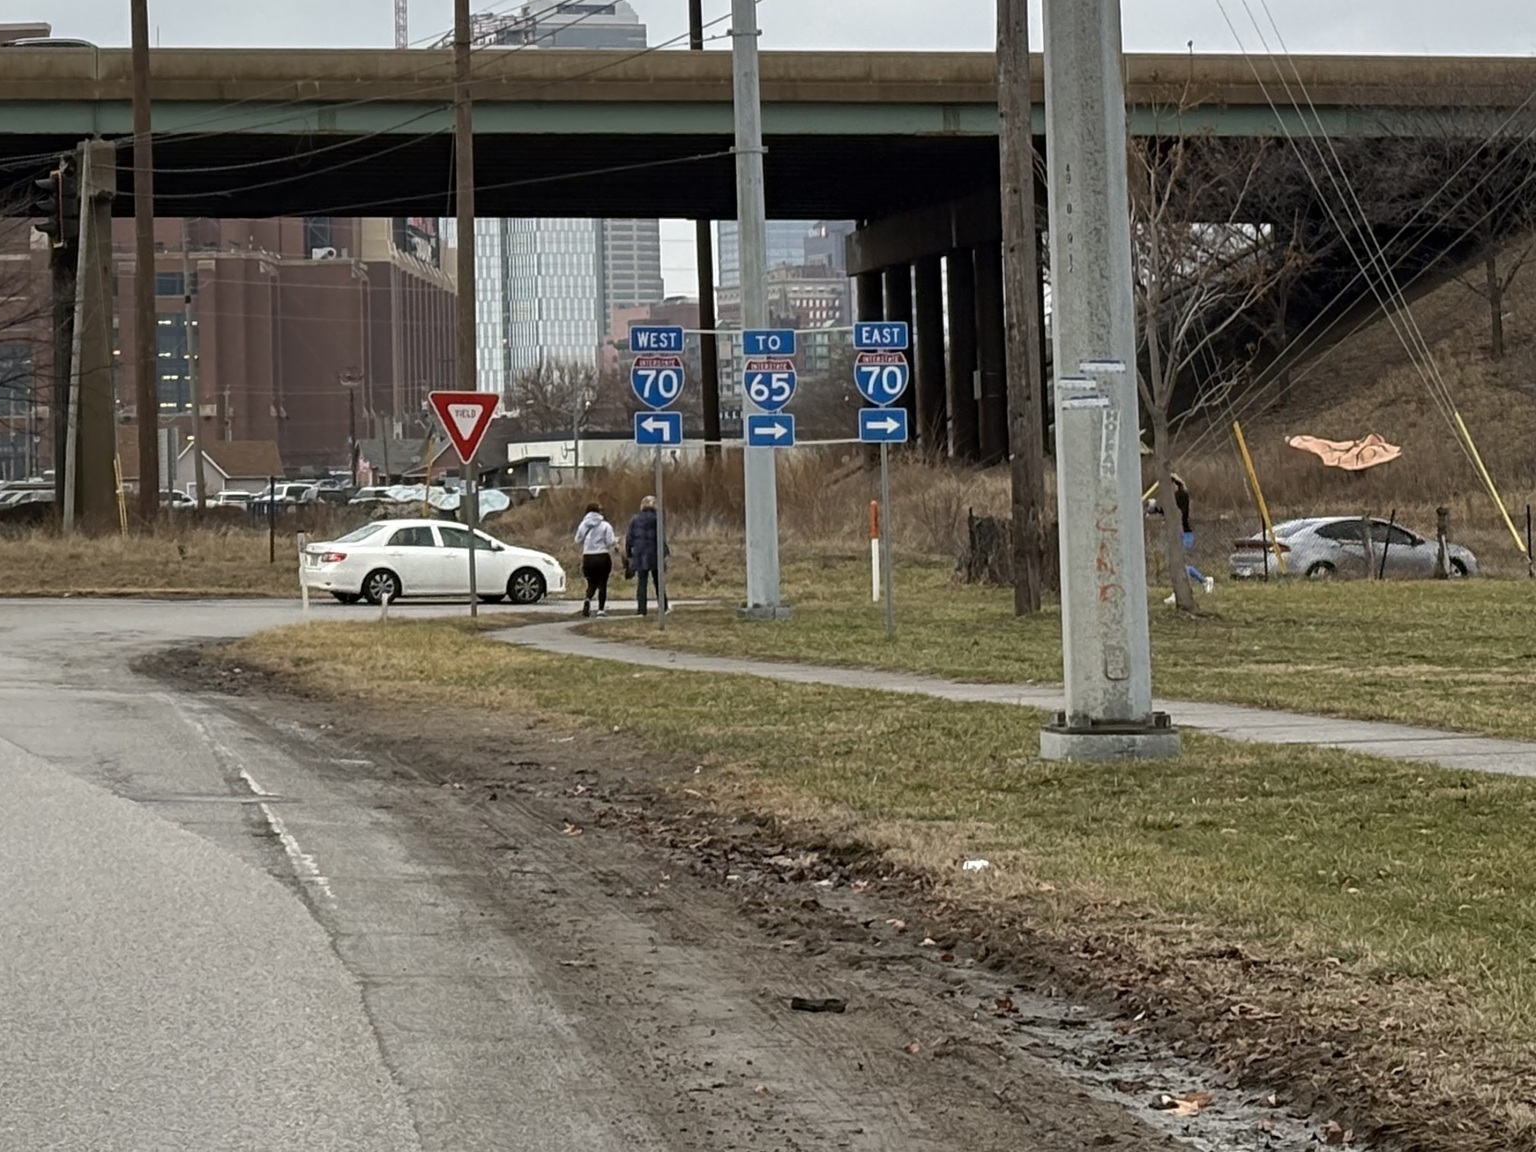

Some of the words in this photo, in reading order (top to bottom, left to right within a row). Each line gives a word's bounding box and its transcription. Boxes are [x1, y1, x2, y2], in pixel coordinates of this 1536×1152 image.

[637, 332, 677, 348] WEST
[755, 335, 781, 351] TO
[862, 327, 901, 344] EAST
[637, 369, 679, 399] 70
[749, 373, 791, 402] 65
[860, 365, 903, 395] 70
[454, 408, 477, 418] YIELD
